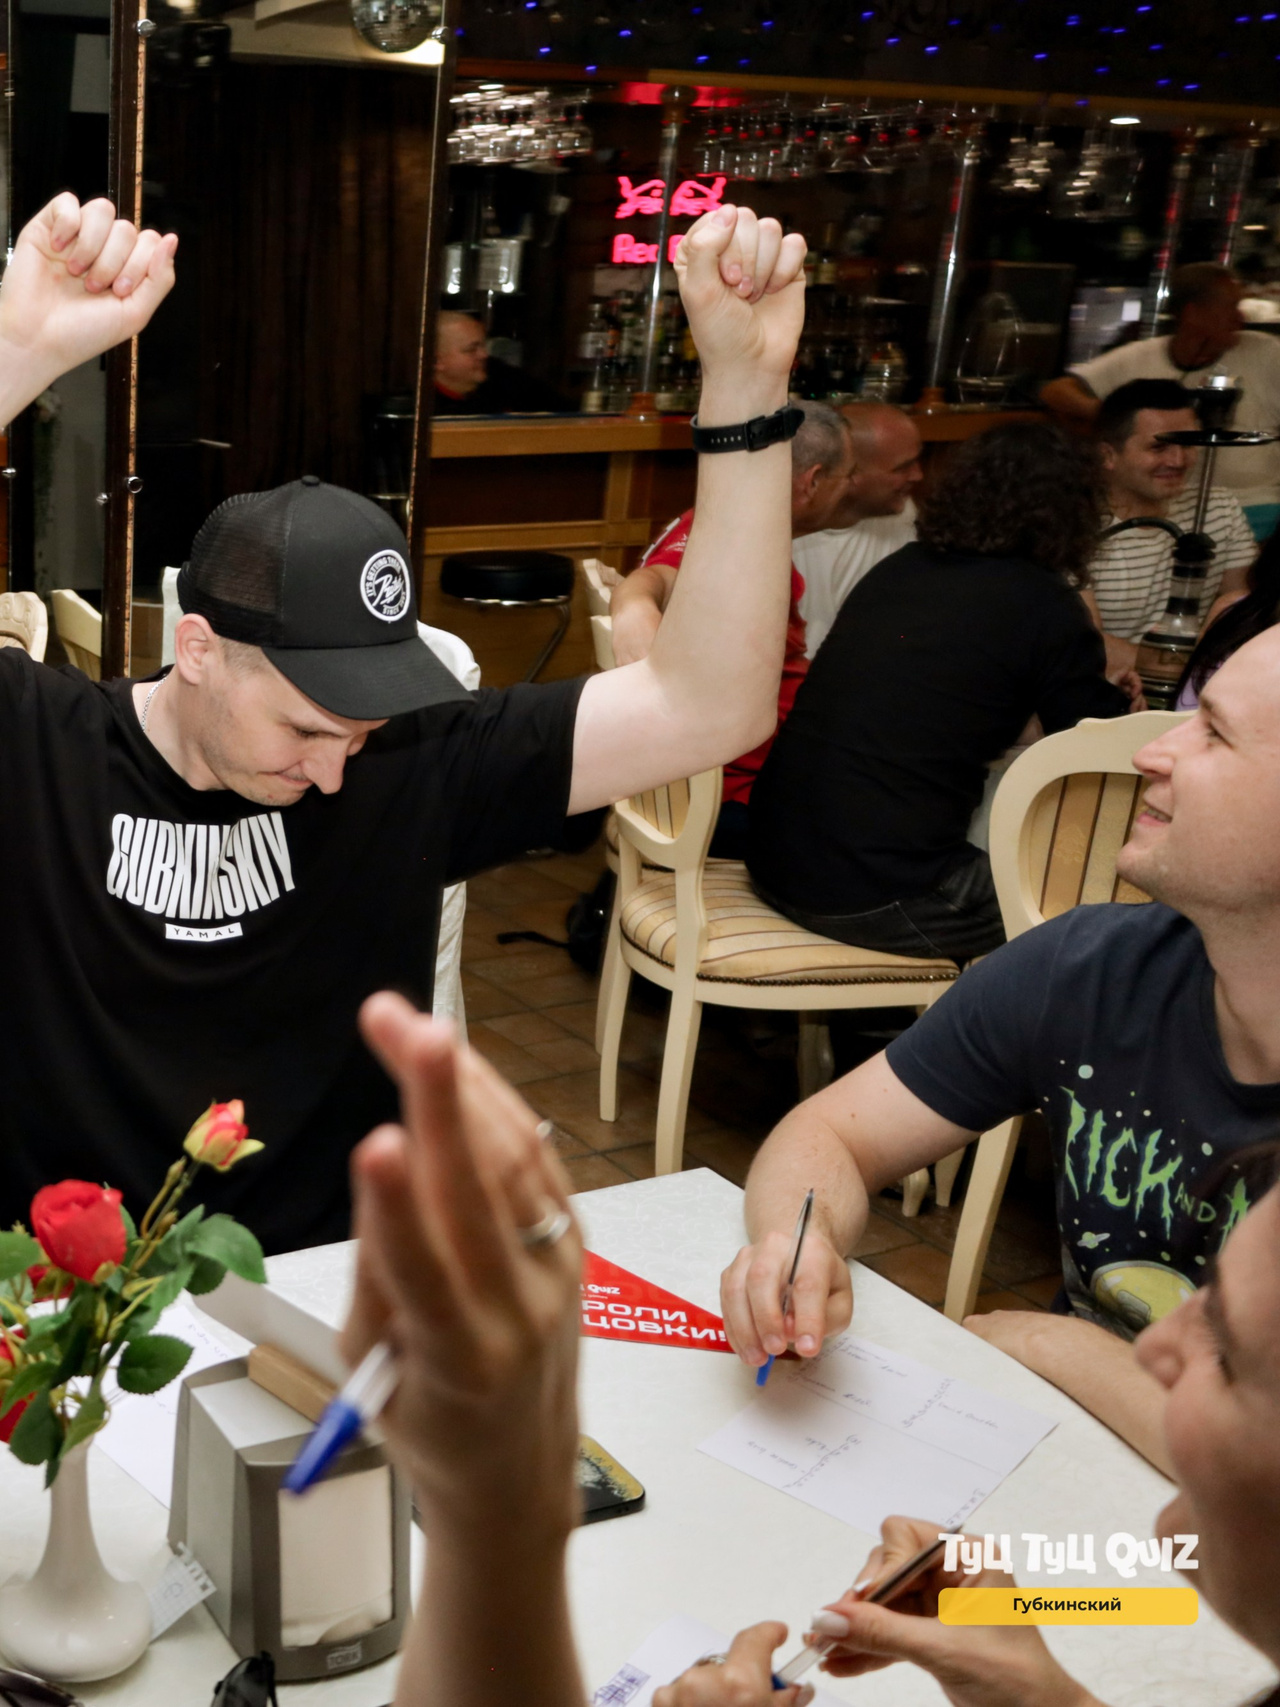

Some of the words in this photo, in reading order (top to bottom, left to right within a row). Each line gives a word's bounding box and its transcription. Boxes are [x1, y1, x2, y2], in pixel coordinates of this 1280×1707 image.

[173, 927, 235, 939] YAMAL
[1174, 1182, 1217, 1222] AND
[582, 1300, 688, 1323] РОЛИ
[582, 1314, 727, 1342] ЦОВКИ!
